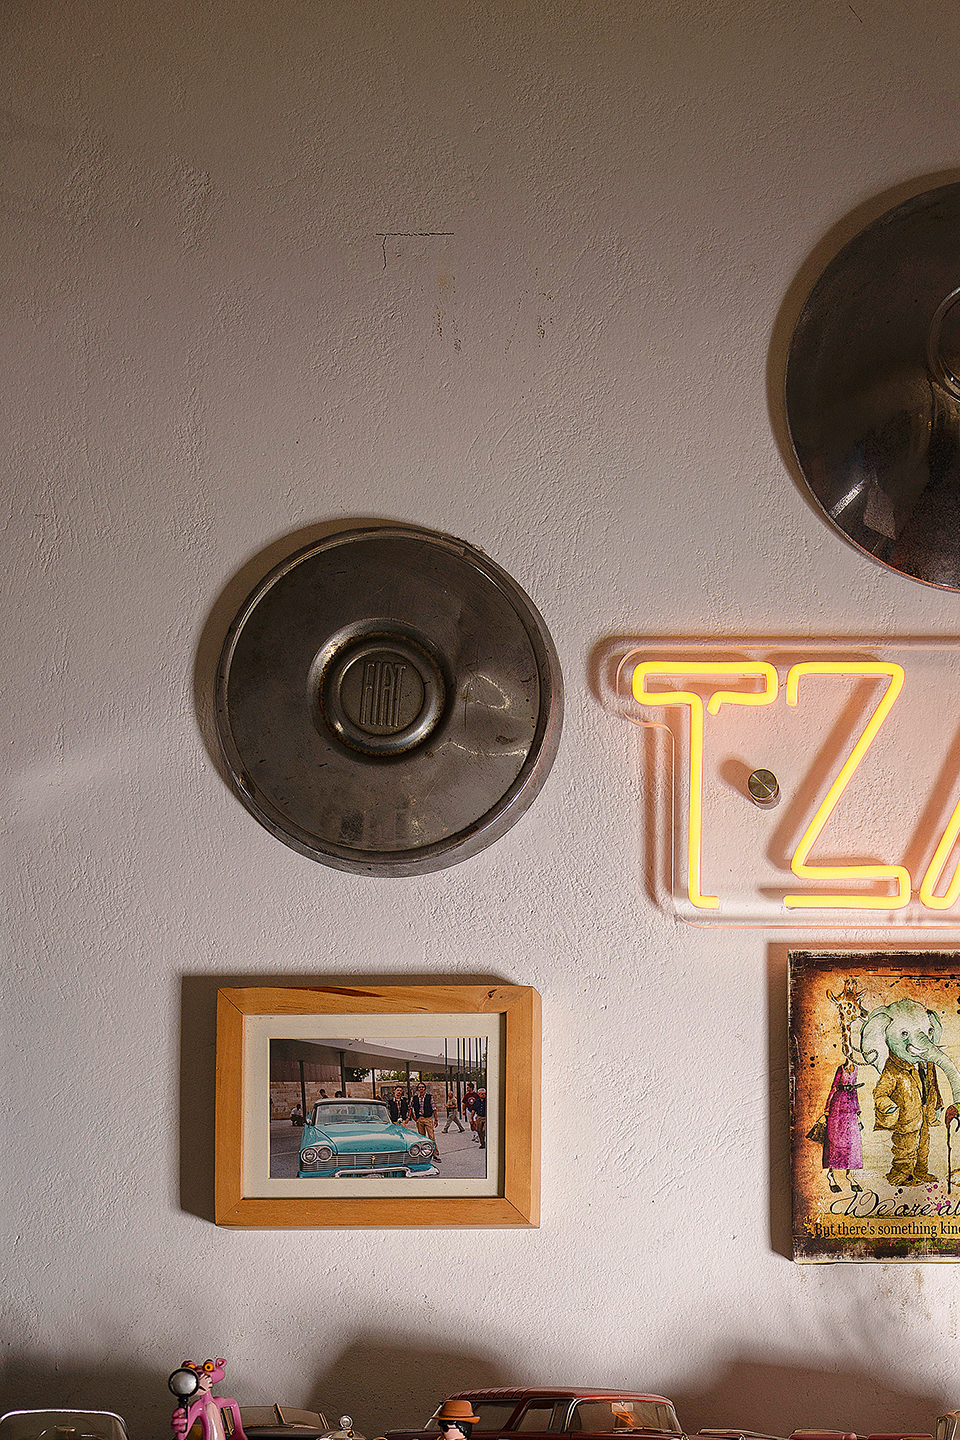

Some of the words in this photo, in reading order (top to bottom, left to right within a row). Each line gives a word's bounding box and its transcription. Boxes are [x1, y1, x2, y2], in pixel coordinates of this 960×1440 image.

[358, 659, 407, 728] FIAT
[829, 1188, 896, 1218] We
[894, 1203, 932, 1216] are
[814, 1222, 834, 1237] But
[837, 1221, 875, 1235] there's
[878, 1221, 937, 1237] something
